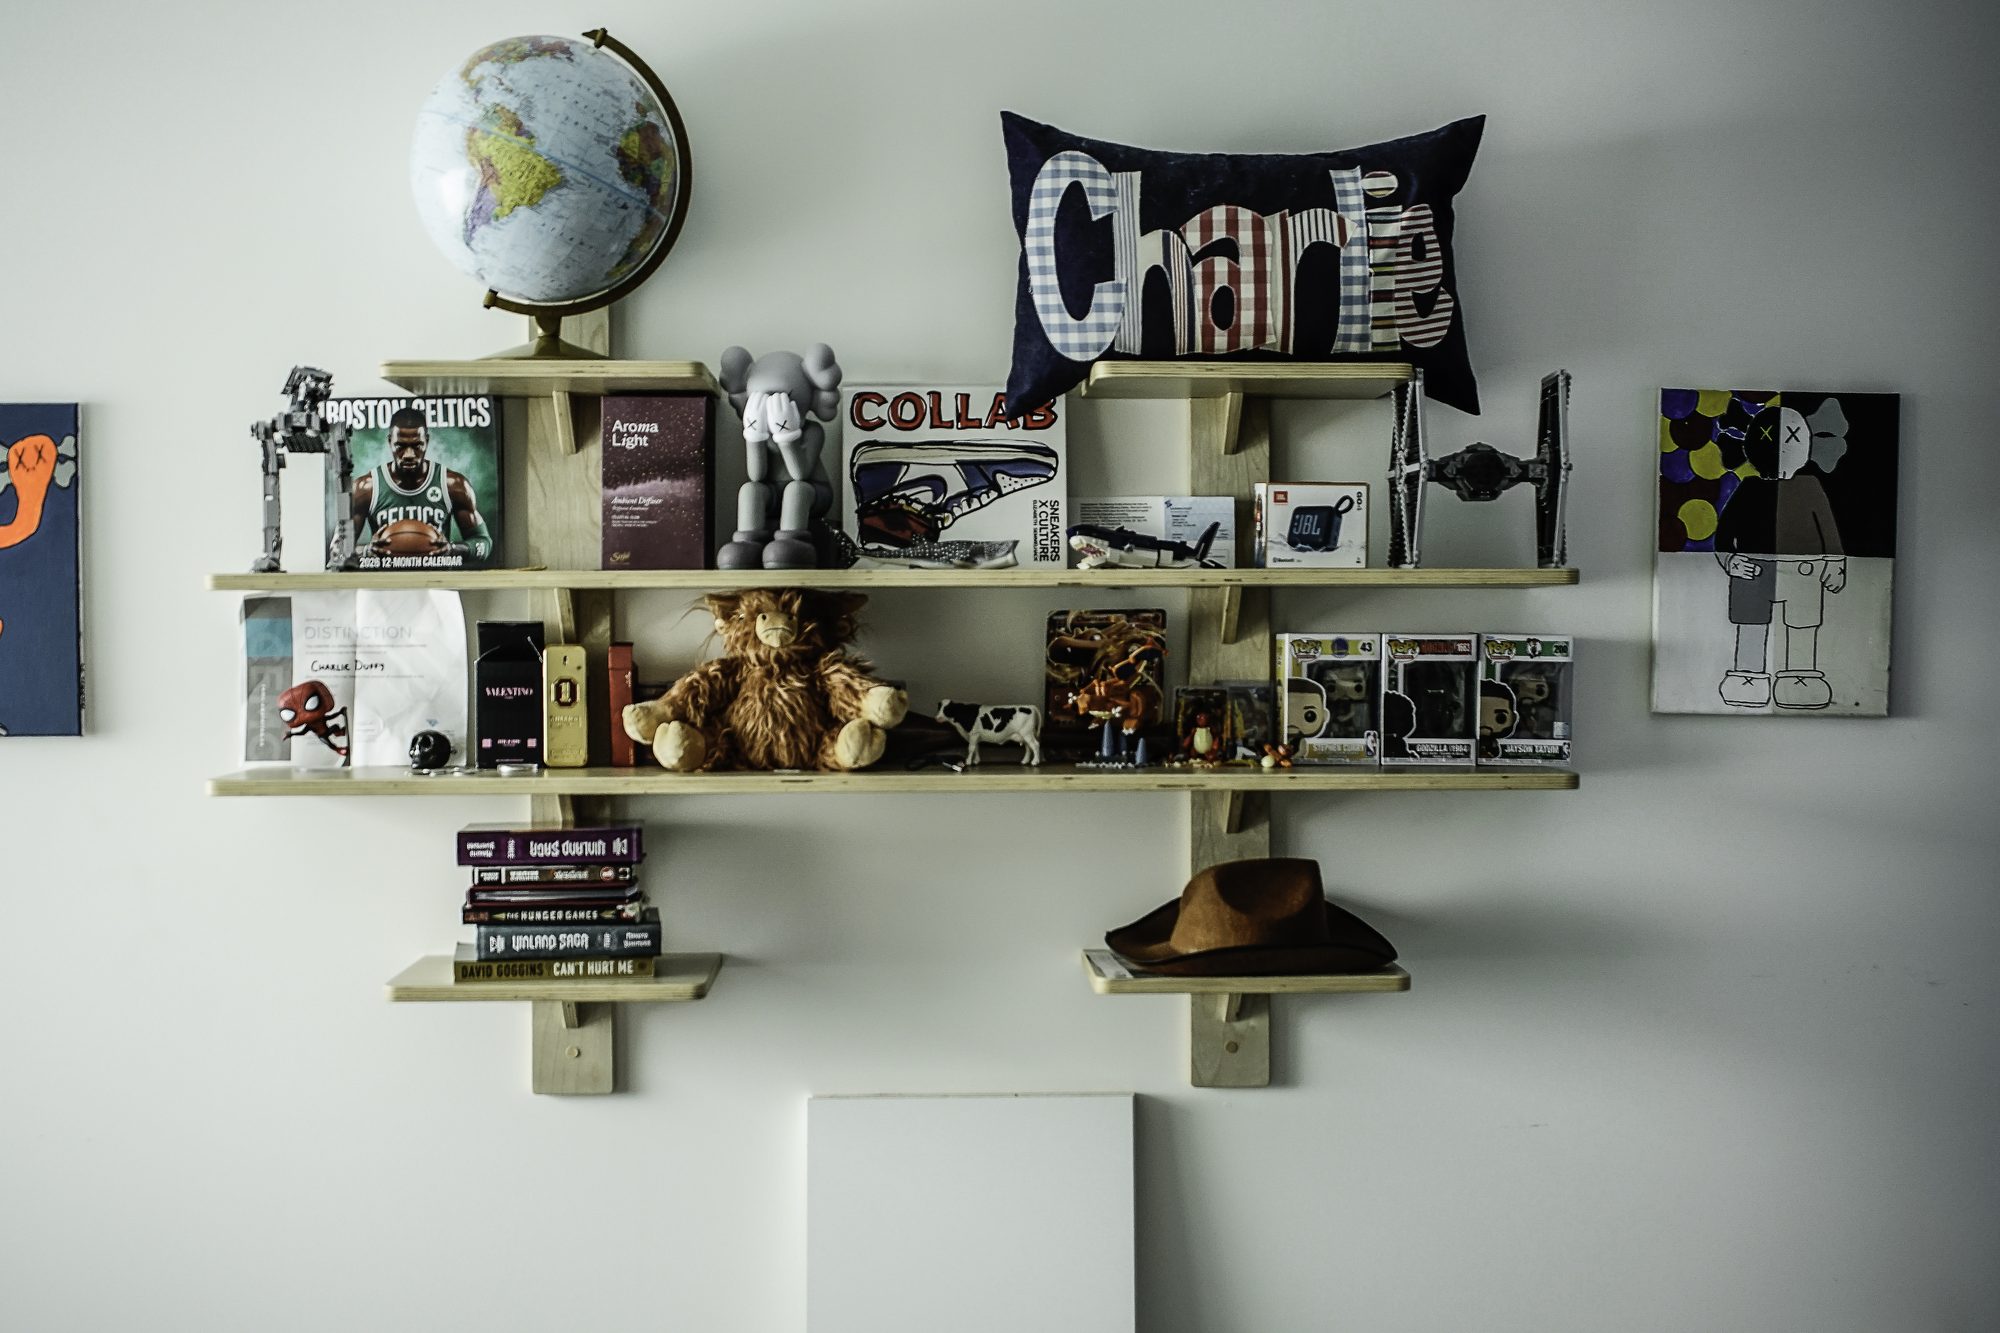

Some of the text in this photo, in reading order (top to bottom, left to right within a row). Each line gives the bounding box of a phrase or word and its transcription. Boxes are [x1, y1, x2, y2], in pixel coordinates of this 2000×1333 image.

[1025, 150, 1453, 361] Charlie
[611, 420, 659, 433] Aroma
[611, 433, 649, 449] Light
[1038, 499, 1049, 562] X CULTURE
[1049, 499, 1061, 562] SNEAKERS
[1292, 514, 1321, 535] JBL
[422, 555, 462, 567] CALENDAR
[304, 625, 413, 640] DISTINCTION
[1360, 642, 1373, 652] 43
[485, 687, 534, 697] VALENTINO
[529, 840, 560, 857] SAGA
[561, 839, 607, 857] VINLAND
[521, 910, 563, 921] HUNGER
[565, 910, 598, 920] GAMES
[511, 934, 557, 951] VINLAND
[559, 933, 590, 950] SAGA
[461, 960, 634, 978] DAVID GOGGINS CAN'T HURT ME
